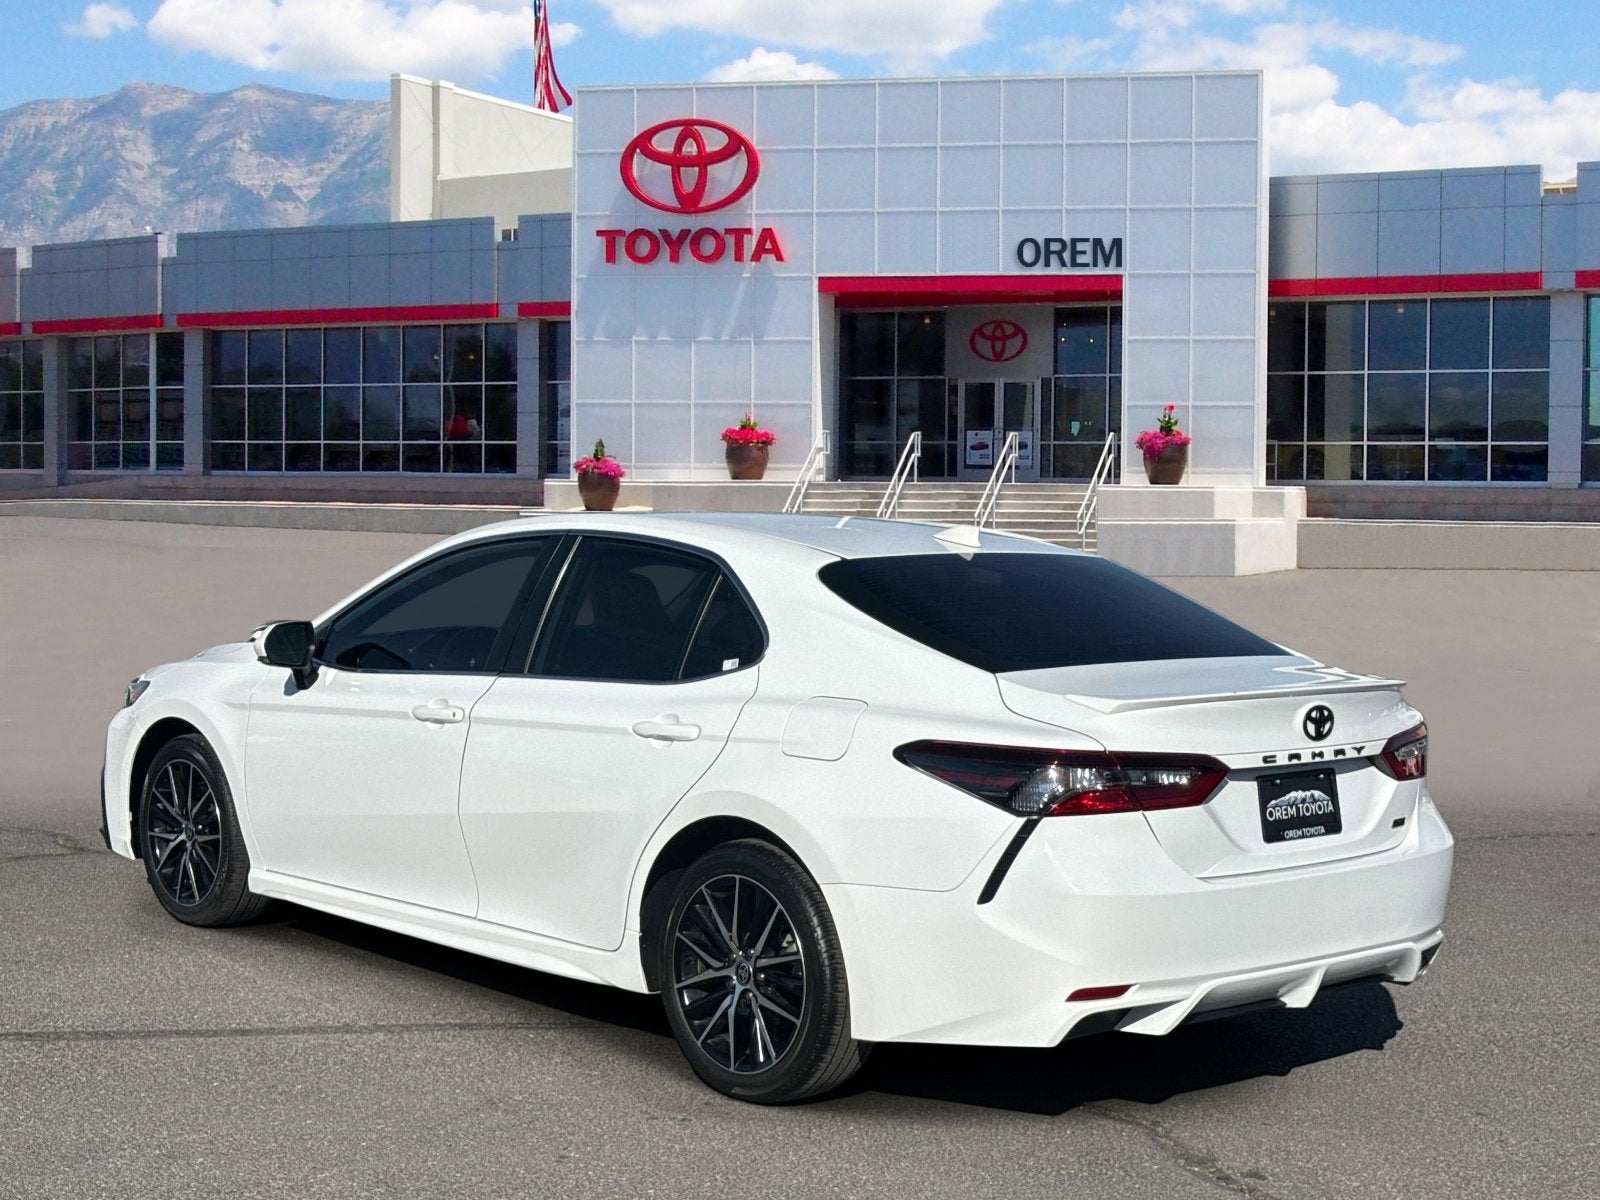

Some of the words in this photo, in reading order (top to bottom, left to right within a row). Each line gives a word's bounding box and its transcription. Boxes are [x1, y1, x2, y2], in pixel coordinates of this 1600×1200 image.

[596, 227, 784, 264] TOYOTA
[1016, 237, 1123, 268] OREM
[1262, 745, 1366, 765] CAMRY
[1266, 804, 1297, 821] OREM
[1297, 800, 1335, 817] TOYOTA
[1284, 828, 1303, 839] OREM
[1303, 825, 1326, 837] TOYOTA
